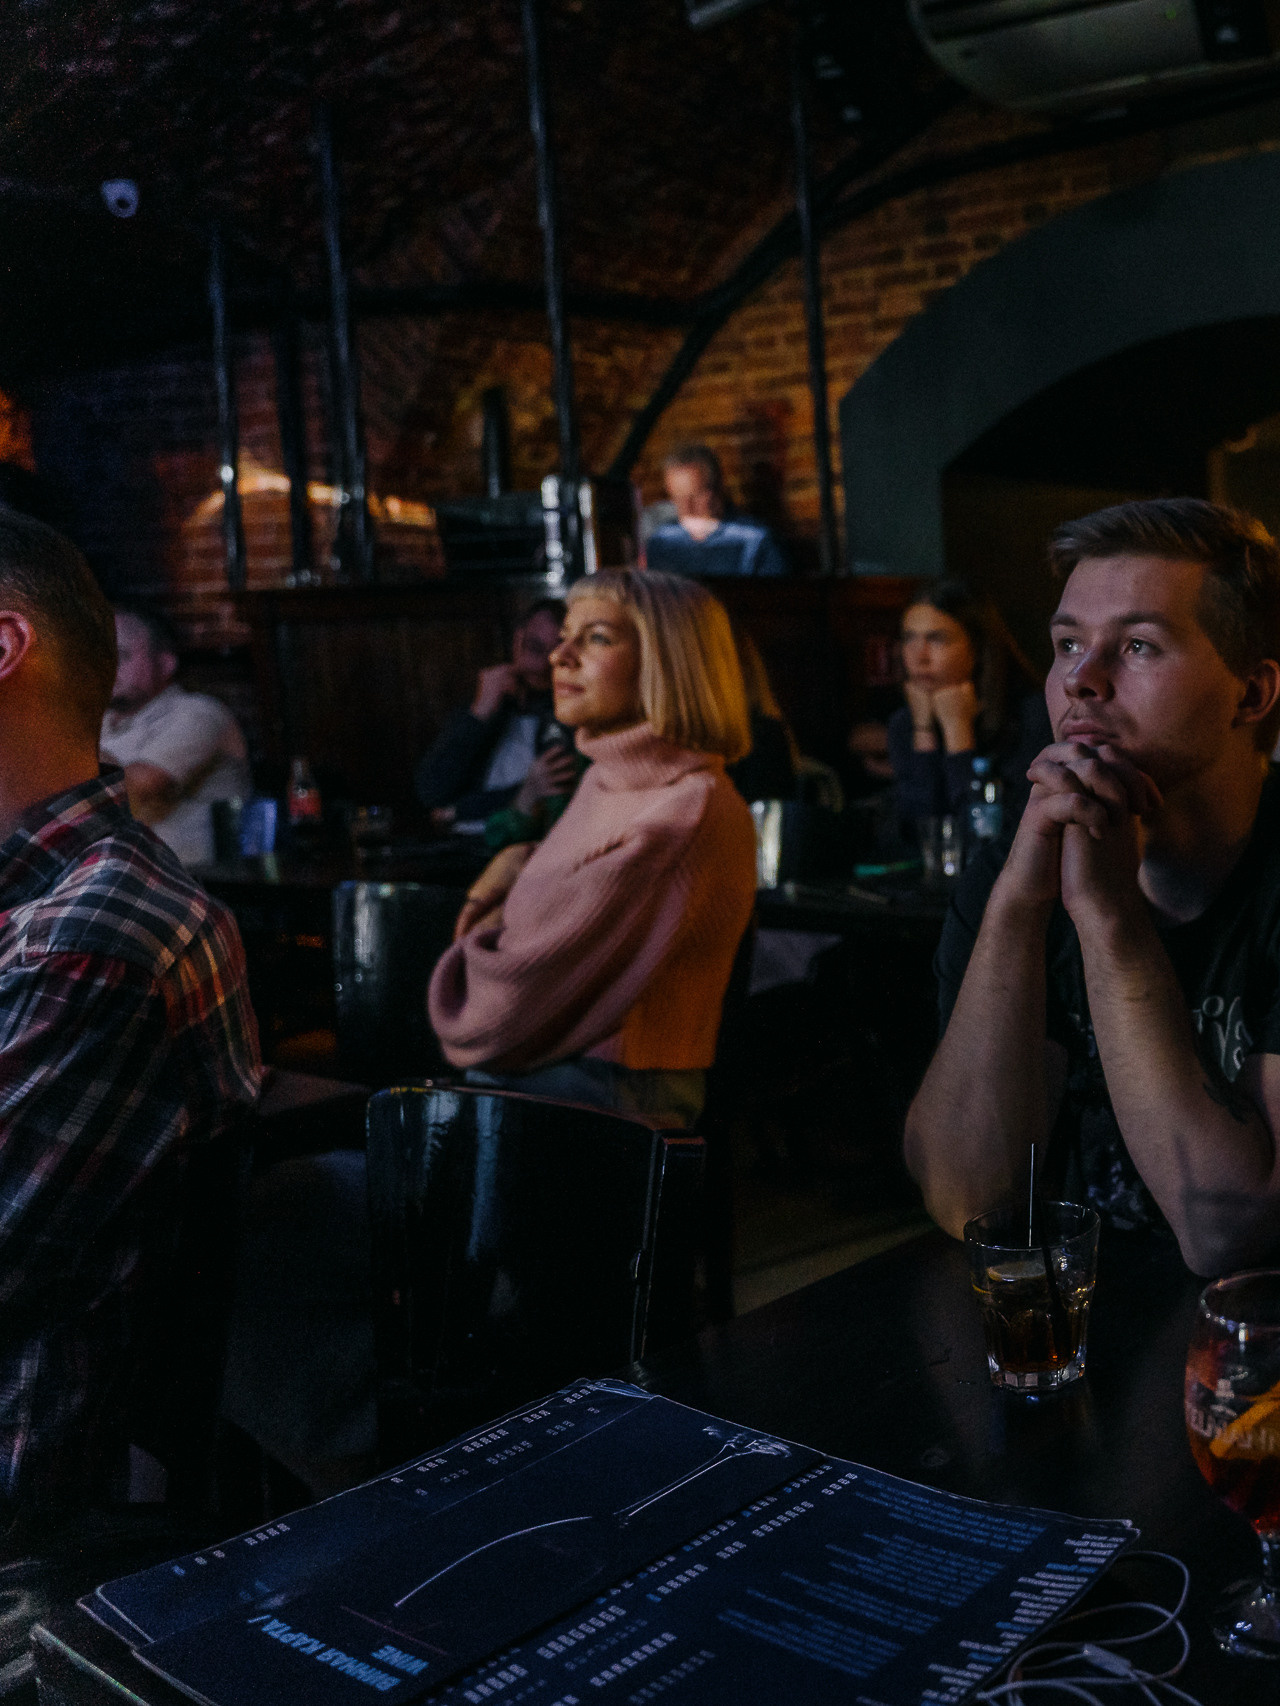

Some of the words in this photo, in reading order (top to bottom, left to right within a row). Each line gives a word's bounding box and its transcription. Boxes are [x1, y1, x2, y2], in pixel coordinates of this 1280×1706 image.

[261, 1618, 326, 1655] КАРТА
[316, 1648, 401, 1691] ВИННАЯ
[371, 1645, 429, 1676] WINE
